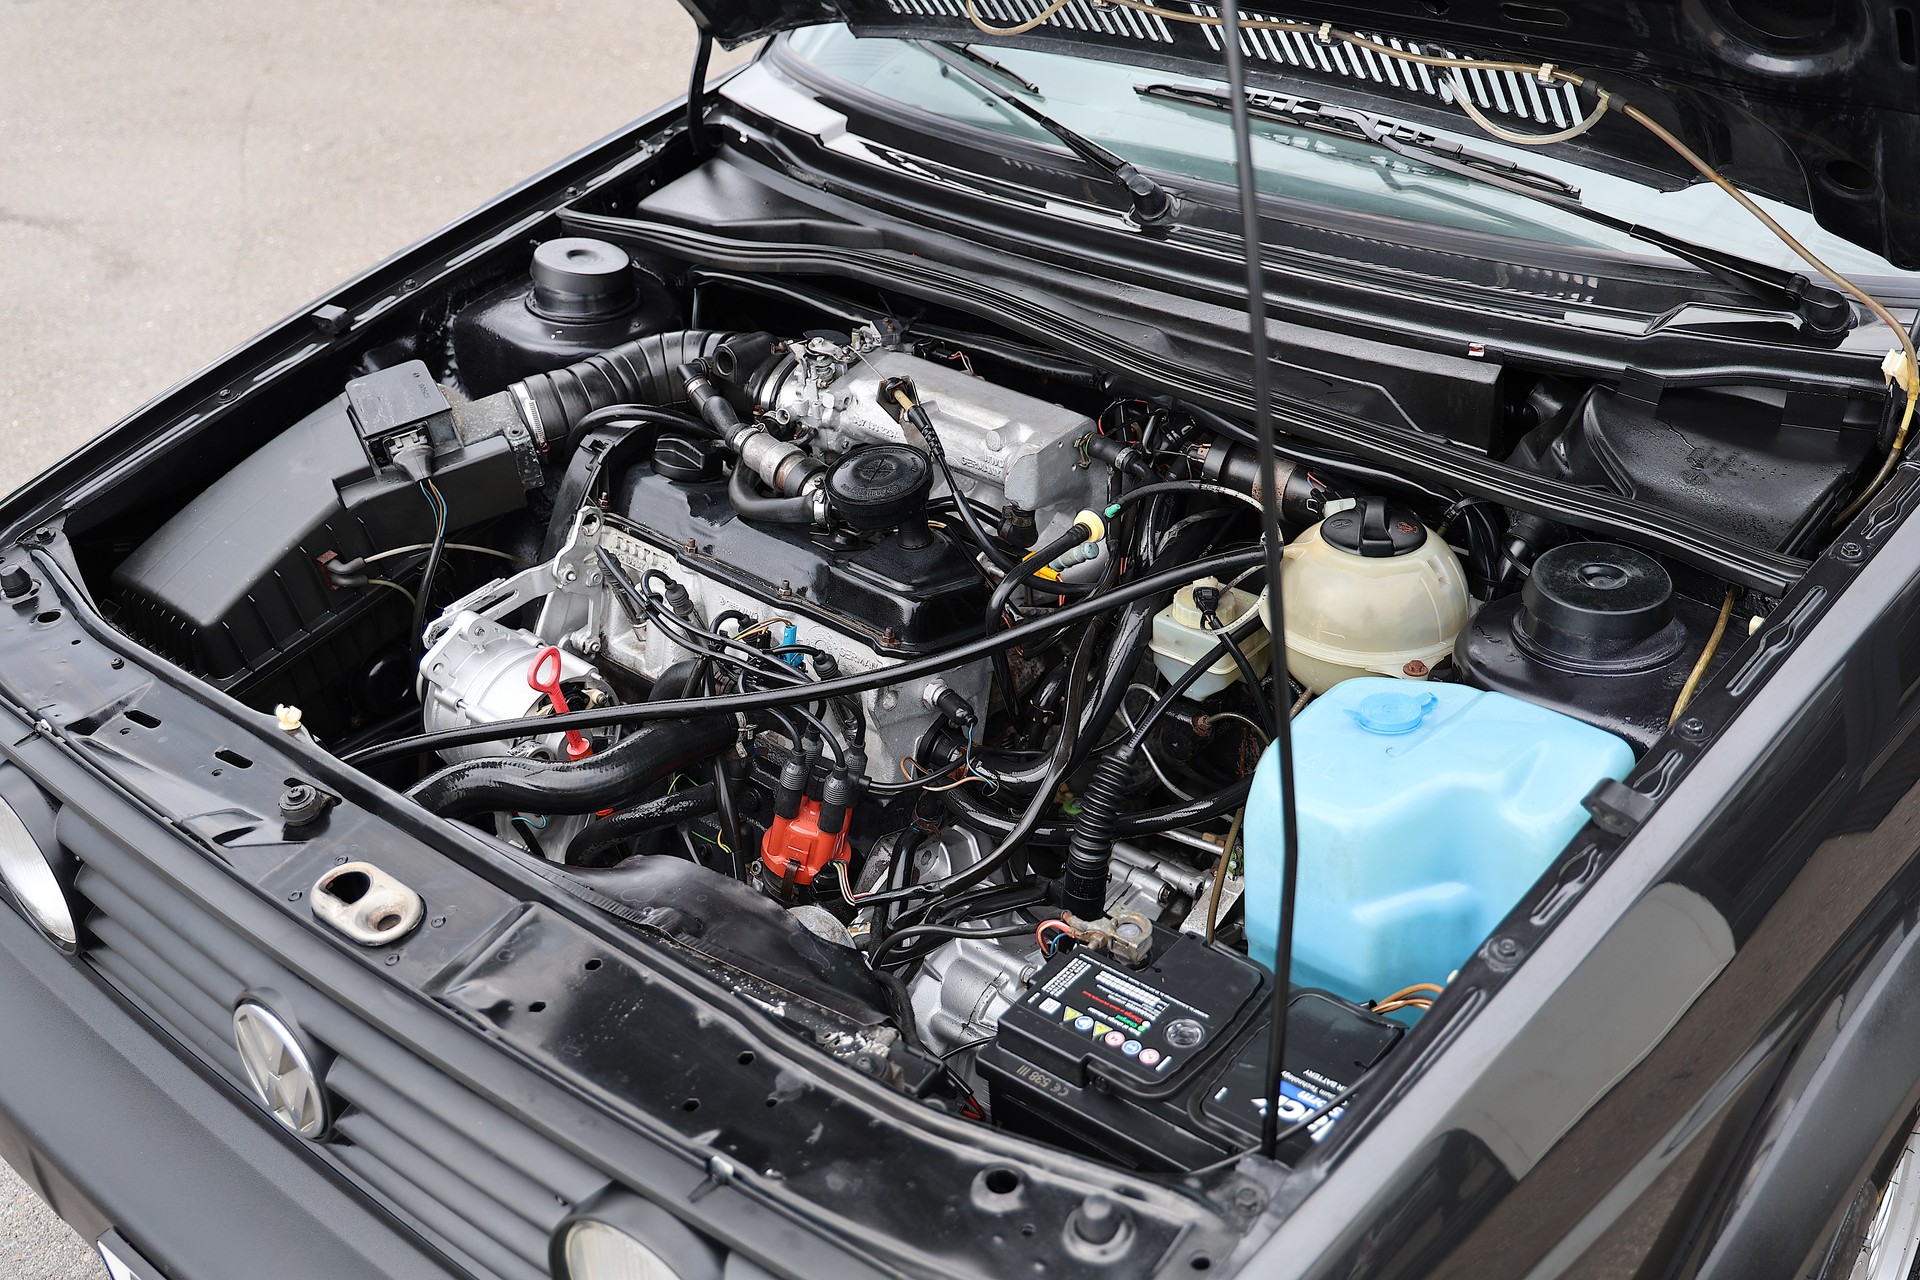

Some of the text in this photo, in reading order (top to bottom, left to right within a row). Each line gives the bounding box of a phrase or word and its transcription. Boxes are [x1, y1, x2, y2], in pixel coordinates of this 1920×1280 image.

[1029, 1071, 1051, 1088] 538
[1281, 1070, 1319, 1093] Technology
[1303, 1069, 1338, 1090] BATTERY
[1297, 1090, 1345, 1119] Sorm
